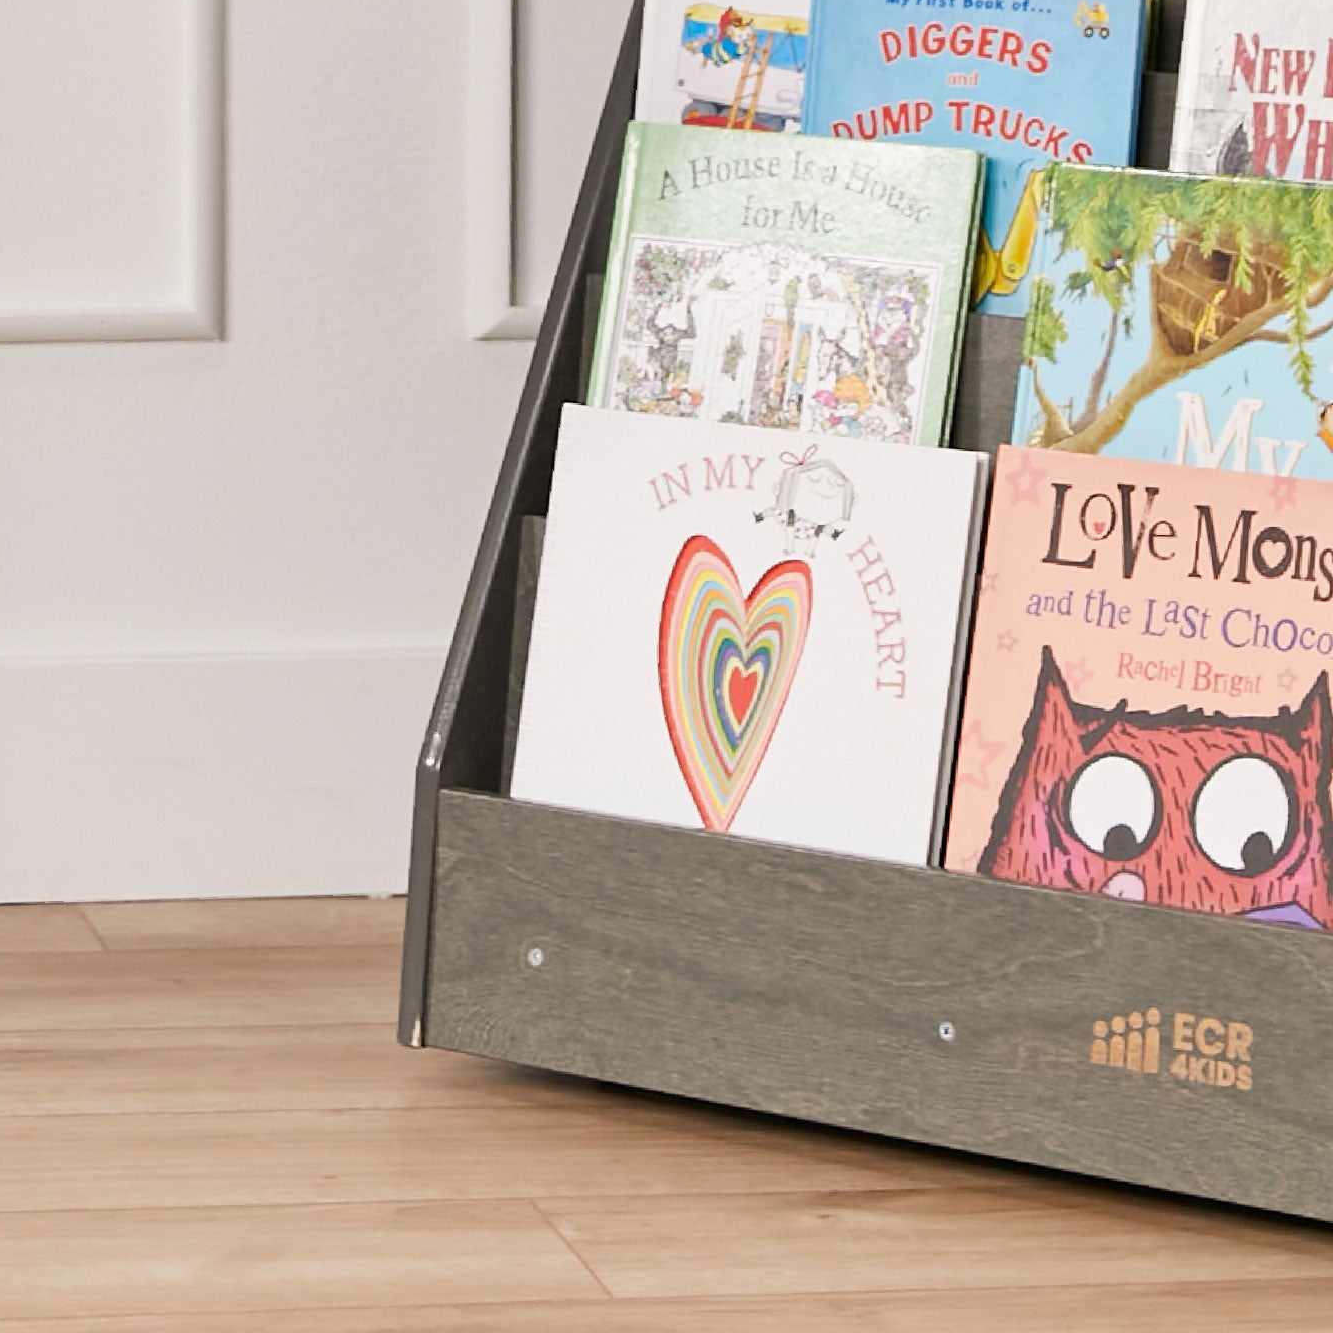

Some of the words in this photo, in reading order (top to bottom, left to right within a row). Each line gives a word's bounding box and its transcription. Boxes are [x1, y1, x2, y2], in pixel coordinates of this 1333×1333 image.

[878, 21, 1053, 75] DIGGERS
[946, 70, 980, 88] and
[831, 100, 933, 141] DUMP
[947, 100, 1093, 164] TRUCKS
[657, 169, 682, 201] A
[688, 155, 781, 190] House
[791, 150, 814, 182] Is
[821, 164, 838, 183] a
[844, 160, 931, 225] House
[741, 193, 782, 228] for
[788, 199, 837, 233] Me
[648, 463, 693, 511] IN
[703, 454, 766, 491] MY
[846, 535, 908, 699] HEART
[1025, 590, 1073, 616] and
[1083, 589, 1132, 629] the
[1117, 652, 1186, 690] Rachel
[1192, 660, 1264, 697] Bright
[1172, 1012, 1254, 1061] ECR
[1169, 1053, 1253, 1091] 4KIDS
